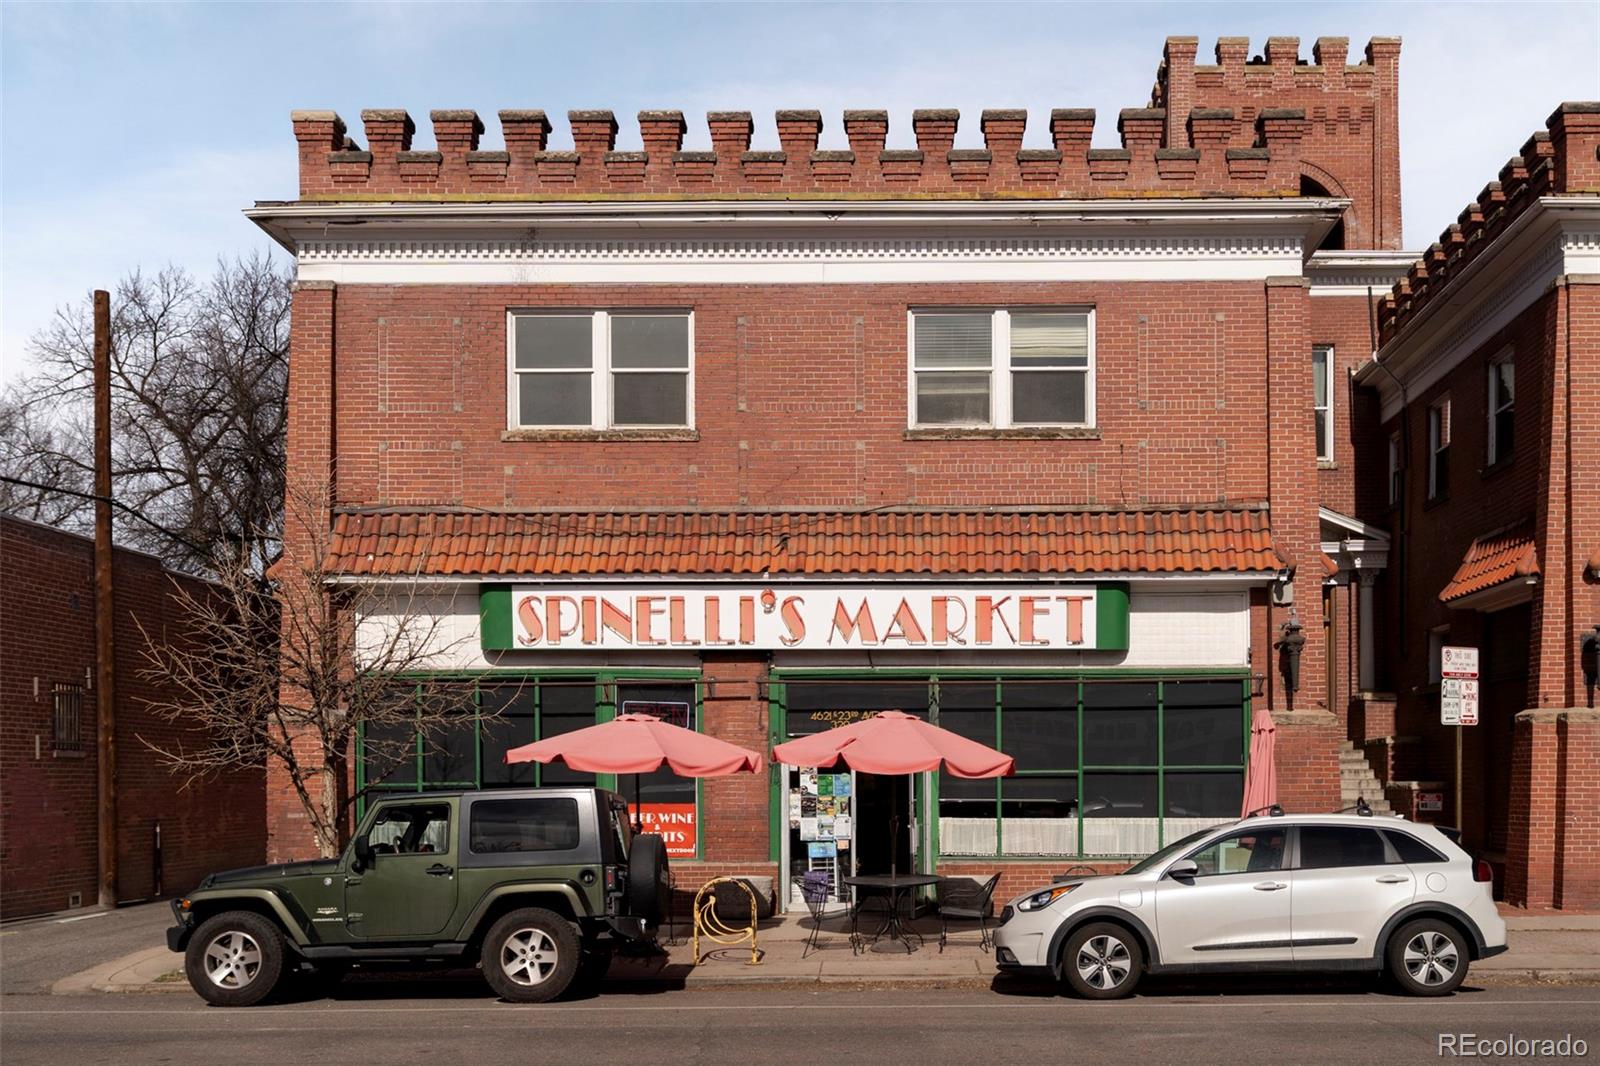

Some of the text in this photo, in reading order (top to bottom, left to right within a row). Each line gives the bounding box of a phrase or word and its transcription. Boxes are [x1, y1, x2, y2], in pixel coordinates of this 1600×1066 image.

[518, 588, 1093, 647] SPINELLI'S MARKET
[630, 813, 694, 824] EER WINE
